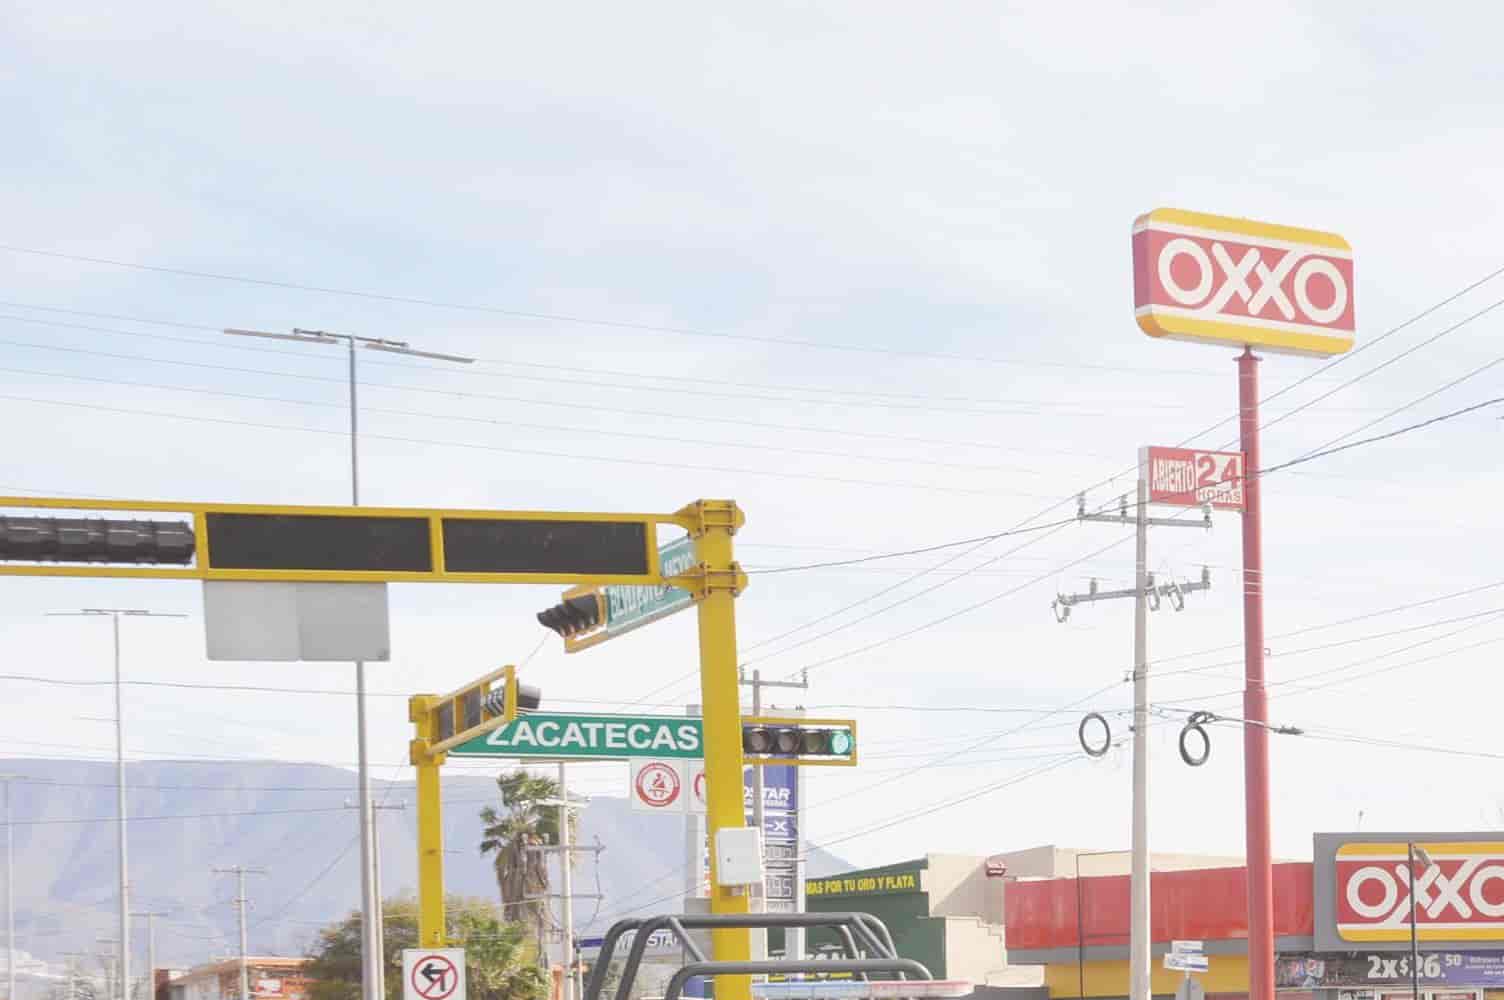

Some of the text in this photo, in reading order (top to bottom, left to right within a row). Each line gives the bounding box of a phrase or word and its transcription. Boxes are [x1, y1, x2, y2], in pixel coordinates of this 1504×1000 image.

[1158, 237, 1348, 323] OXXO
[1151, 454, 1240, 493] ABIERTO 24
[486, 720, 699, 751] ZACATECAS
[844, 878, 856, 892] TU
[878, 876, 885, 889] Y
[886, 874, 915, 888] PLATA
